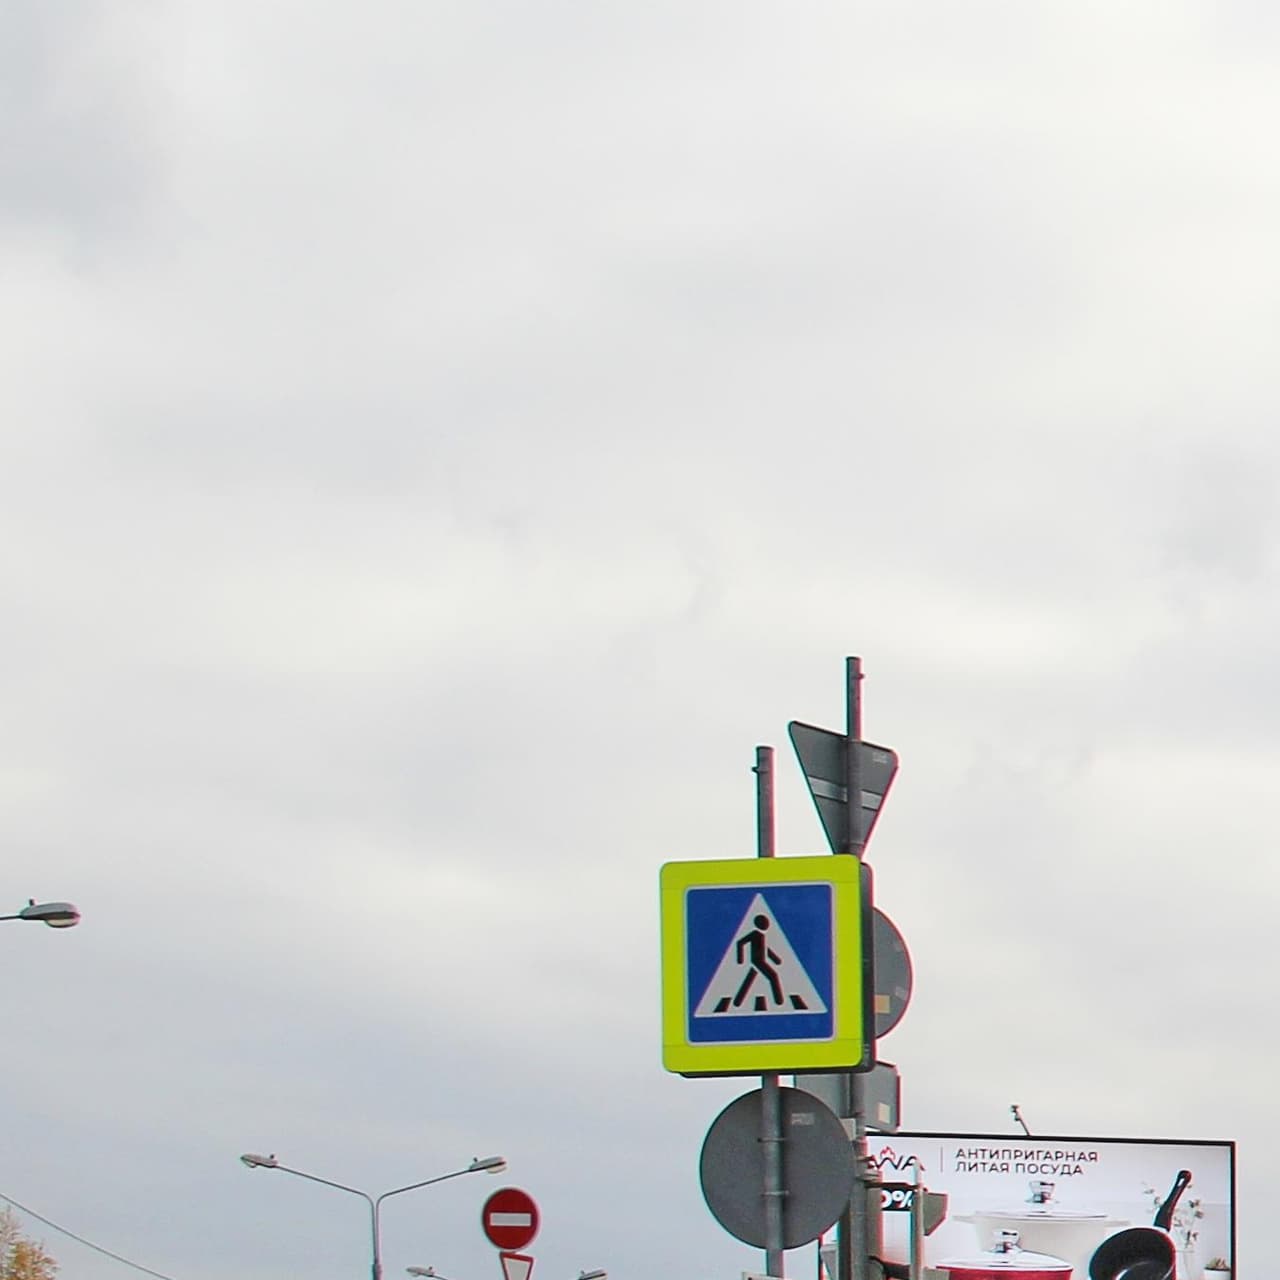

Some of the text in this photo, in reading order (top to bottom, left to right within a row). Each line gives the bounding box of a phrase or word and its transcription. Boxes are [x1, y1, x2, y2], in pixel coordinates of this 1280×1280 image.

[955, 1148, 1098, 1162] АНТИПРИГАРНАЯ
[955, 1161, 1084, 1175] ЛИТАЯ ПОСУДА
